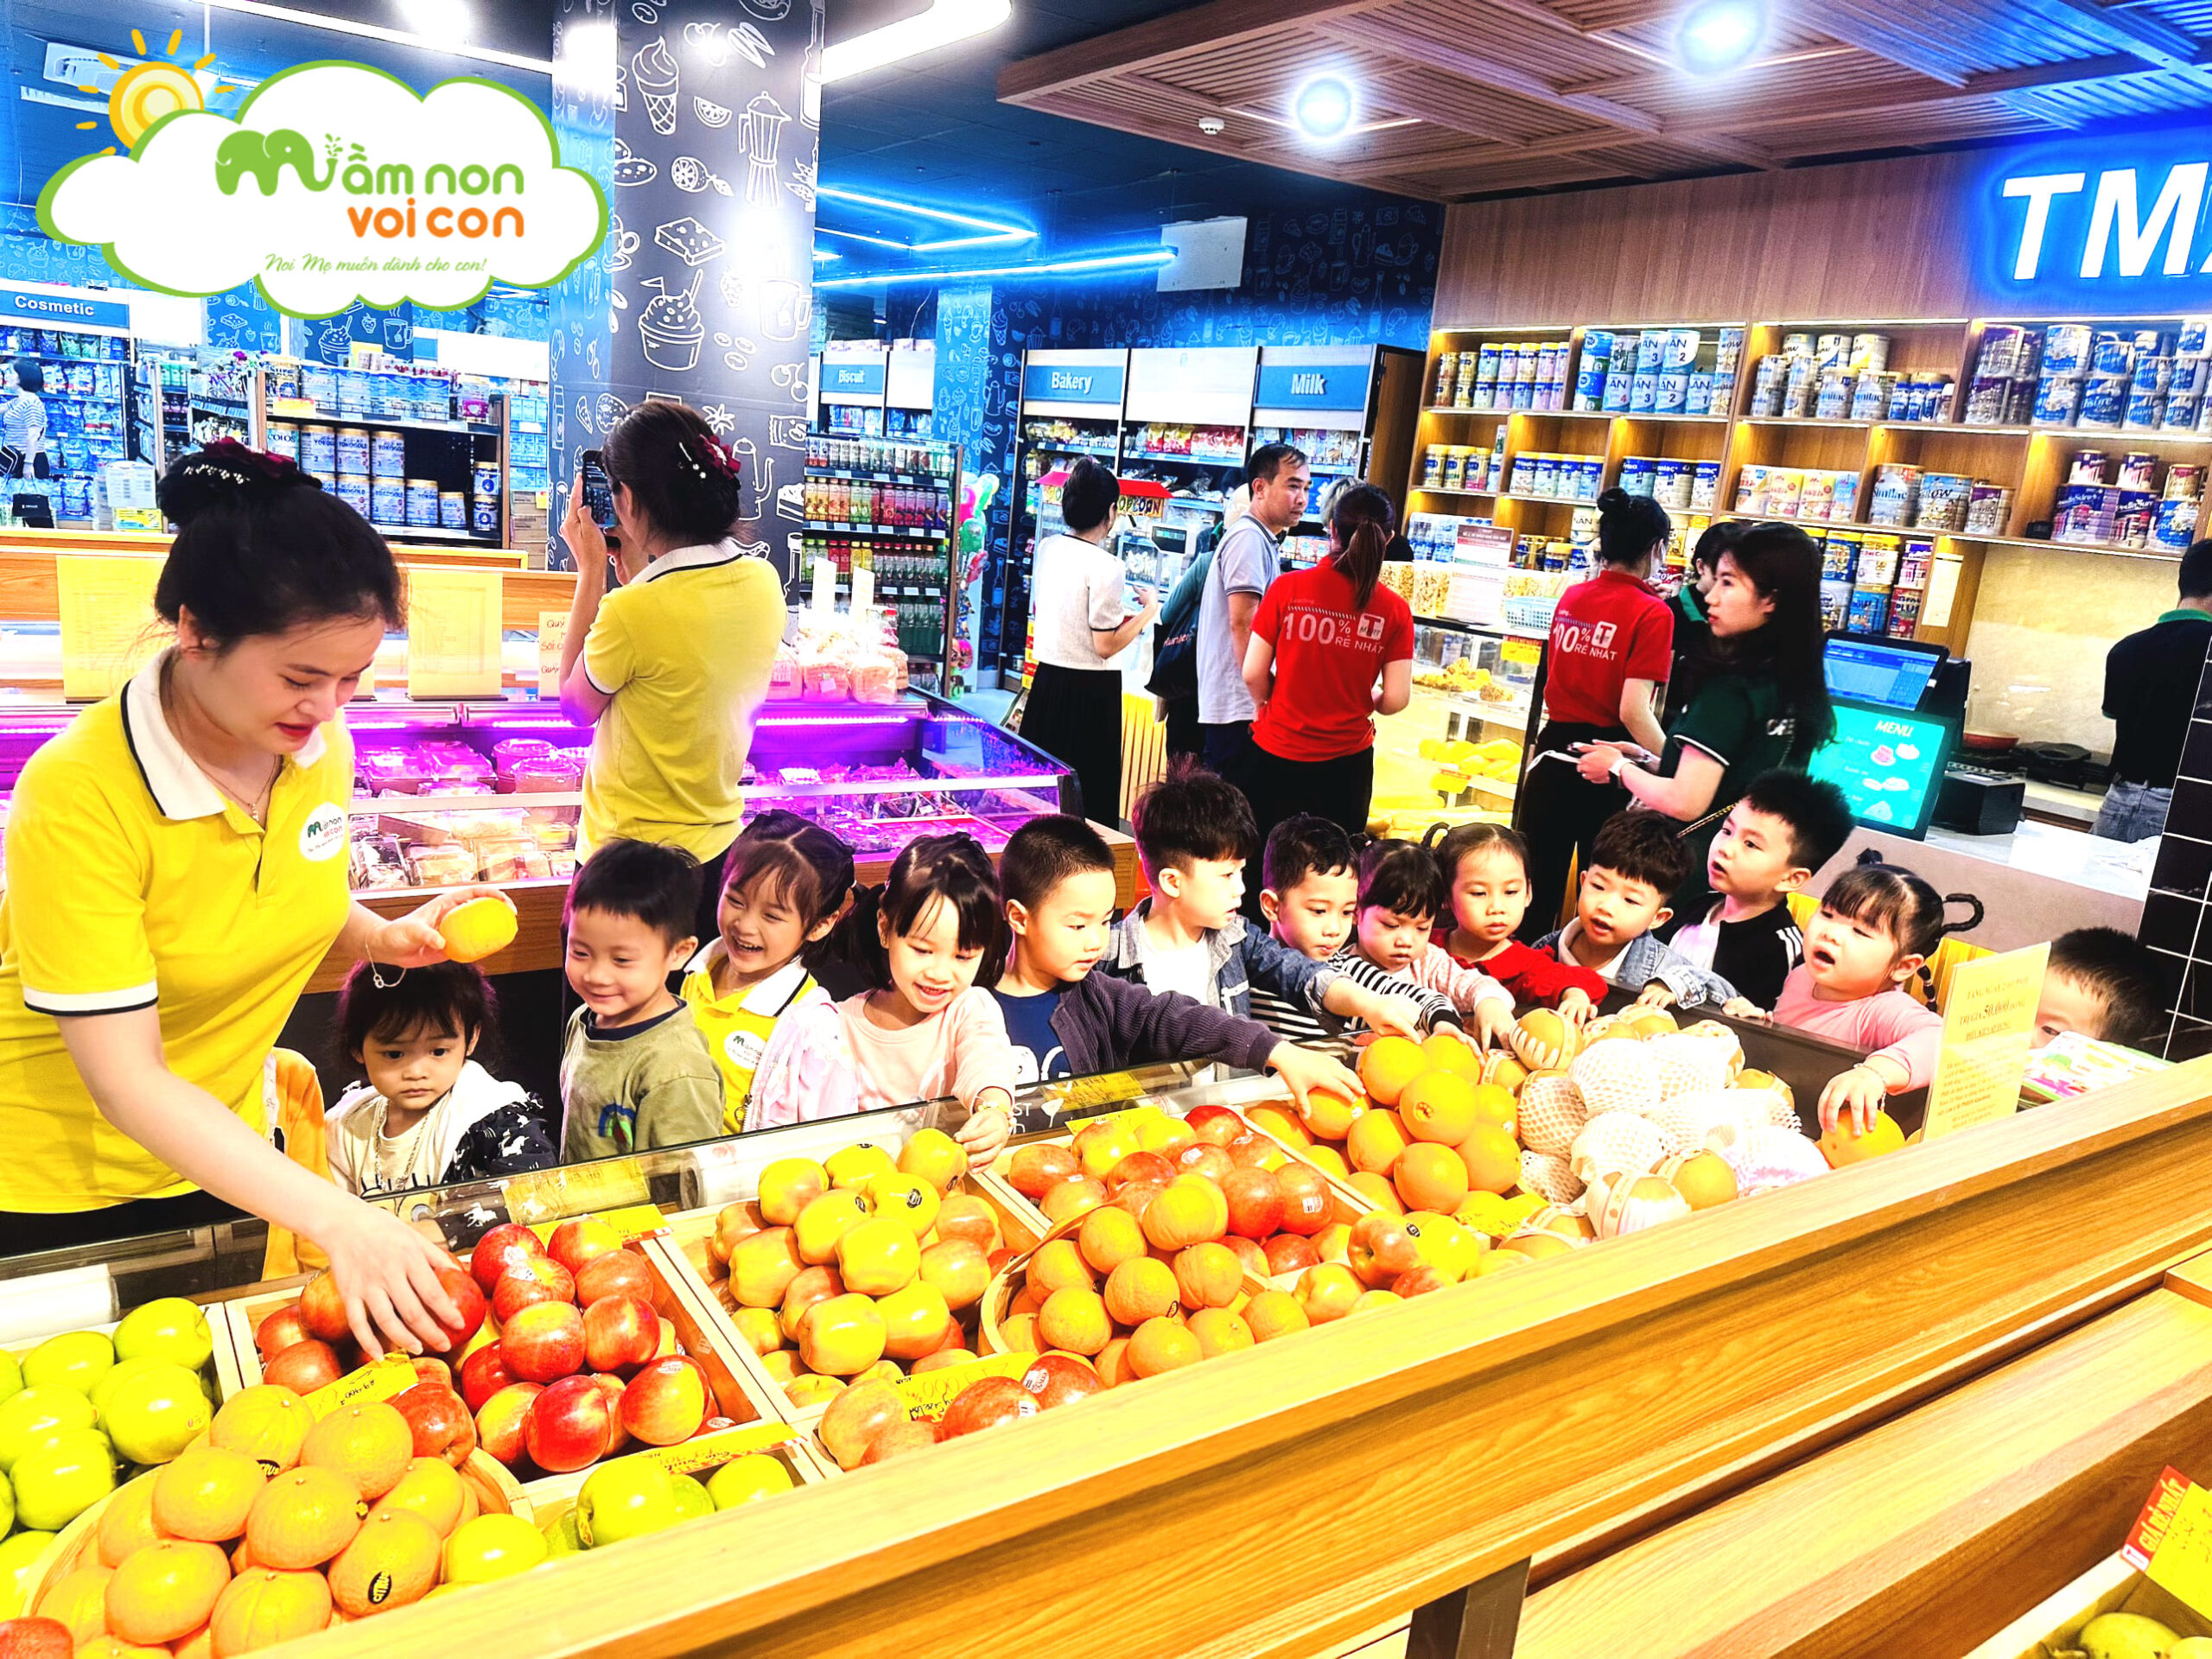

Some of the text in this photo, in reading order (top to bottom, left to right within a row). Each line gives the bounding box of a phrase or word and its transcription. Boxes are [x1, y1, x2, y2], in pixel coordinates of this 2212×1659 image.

[2003, 162, 2212, 280] TM
[15, 295, 95, 317] Cosmetic
[1679, 353, 1686, 362] 2
[838, 370, 866, 385] Biscuit
[1051, 371, 1093, 395] Bakery
[1290, 373, 1327, 396] Milk
[1644, 394, 1651, 403] 3
[1669, 394, 1675, 403] 2
[1335, 634, 1351, 648] RẺ
[1874, 720, 1914, 737] MENU
